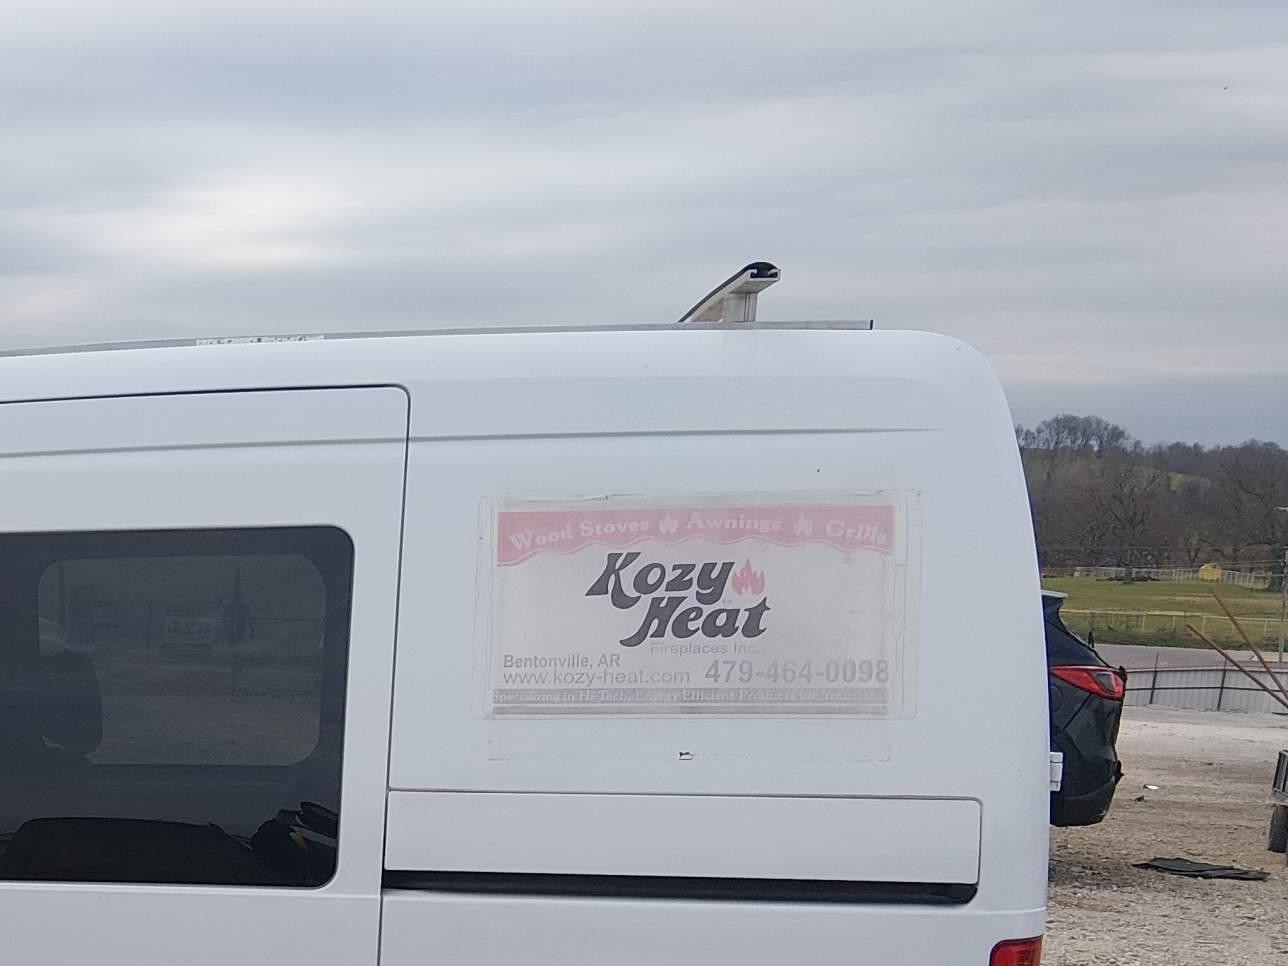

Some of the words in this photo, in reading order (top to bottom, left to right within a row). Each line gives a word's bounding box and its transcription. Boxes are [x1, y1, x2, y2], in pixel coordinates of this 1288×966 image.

[509, 523, 573, 549] Wood
[580, 519, 649, 537] Stoves
[585, 552, 735, 609] Kozy
[619, 596, 771, 647] Heat
[650, 642, 728, 656] Fireplaces
[503, 653, 593, 670] Bentonville,
[597, 653, 621, 667] AR
[705, 659, 889, 683] 479-464-0098
[503, 669, 691, 687] www.kozy-heat.com
